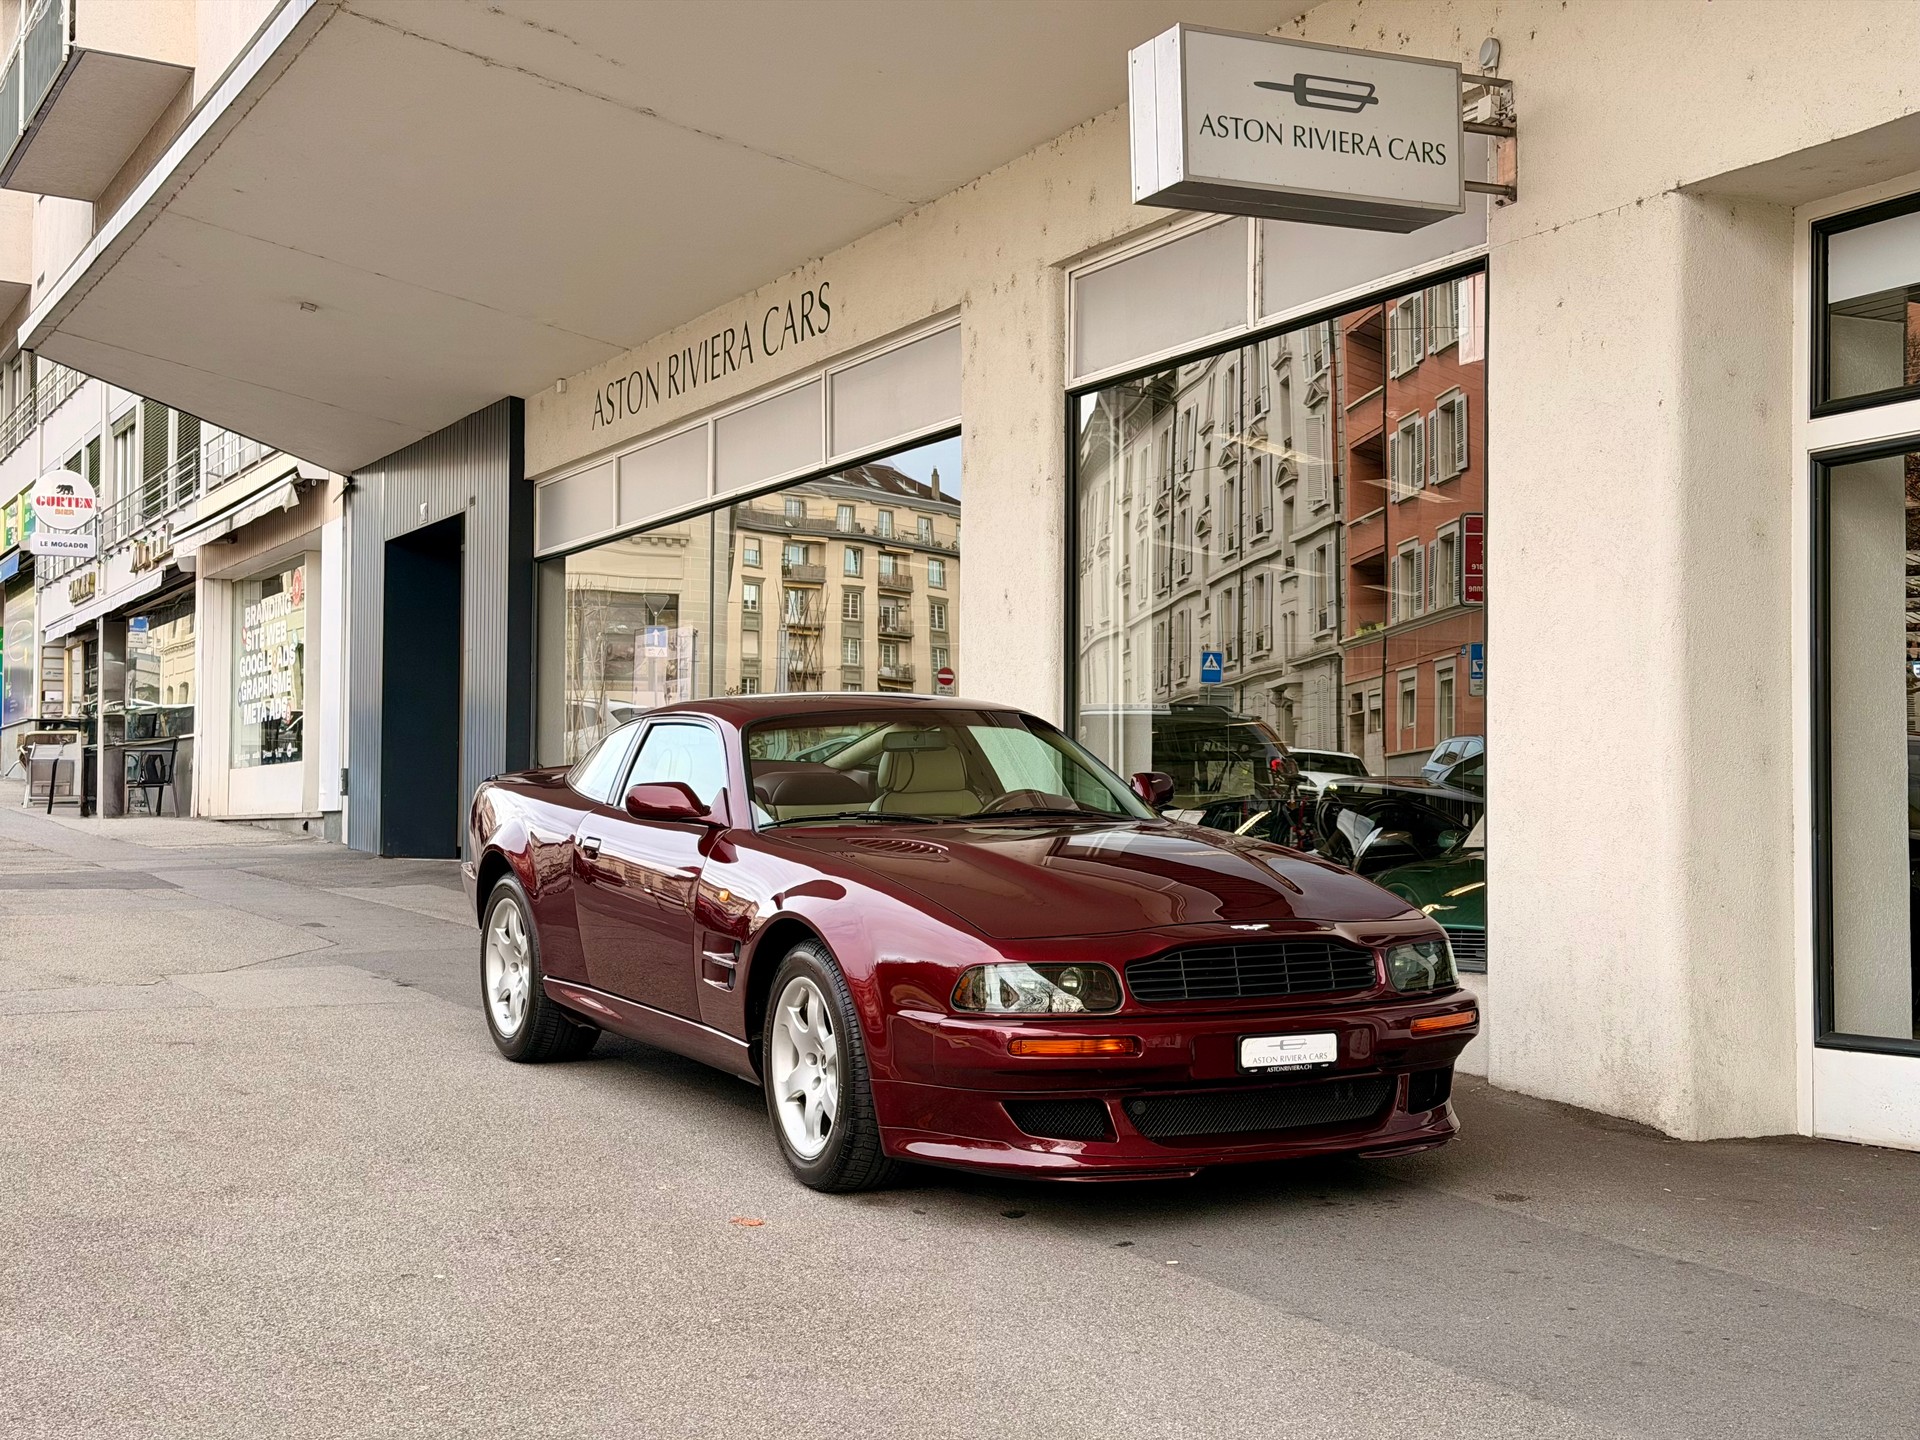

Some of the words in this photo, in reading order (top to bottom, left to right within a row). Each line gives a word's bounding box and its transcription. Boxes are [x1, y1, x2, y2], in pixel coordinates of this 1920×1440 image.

[1199, 113, 1283, 145] ASTON
[1293, 125, 1382, 158] RIVIERA
[1388, 137, 1447, 166] CARS
[591, 361, 660, 431] ASTON
[668, 320, 754, 399] RIVIERA
[762, 281, 831, 357] CARS
[36, 495, 92, 509] GURTEN
[51, 541, 88, 549] MOGADOR
[245, 593, 291, 628] BRANDING
[246, 626, 264, 652] SITE
[266, 620, 287, 646] WEB
[240, 649, 272, 678] GOOGLE
[277, 643, 296, 668] ADS
[241, 669, 291, 702] GRAPHISME
[244, 700, 267, 726] META
[269, 697, 288, 721] ADS
[1253, 1056, 1278, 1065] ASTON
[1280, 1054, 1307, 1063] RIVIERA
[1309, 1051, 1328, 1060] CARS
[1267, 1064, 1312, 1073] ASTONRIVIERA.CH
